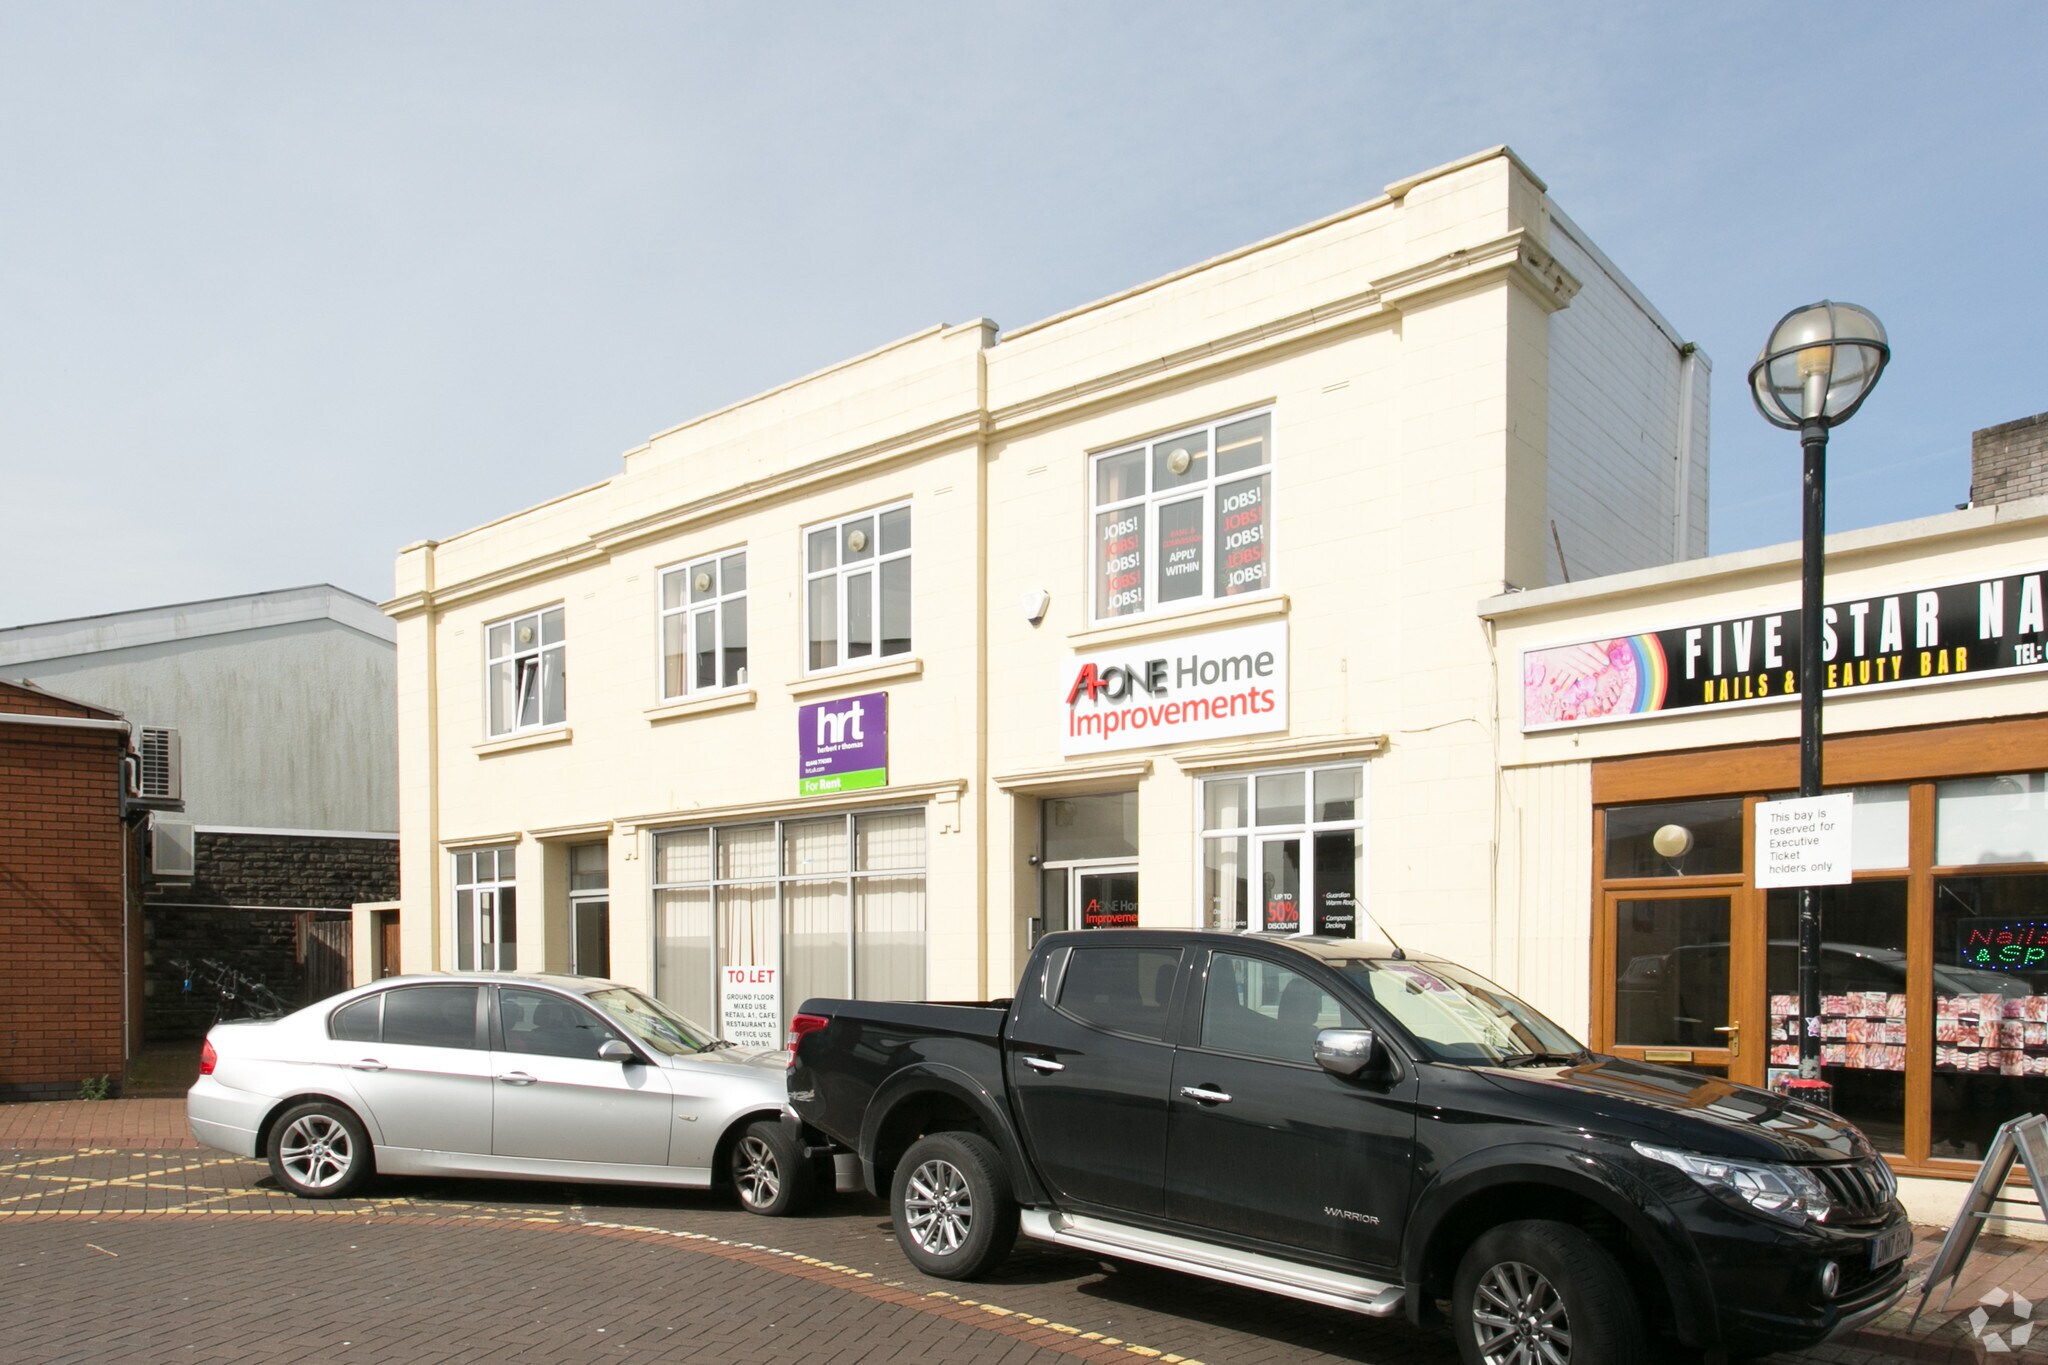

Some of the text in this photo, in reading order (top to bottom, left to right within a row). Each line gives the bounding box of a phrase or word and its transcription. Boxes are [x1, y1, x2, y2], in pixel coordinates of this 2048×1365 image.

[1222, 487, 1261, 514] JOBS!
[1104, 517, 1138, 540] JOBS!
[1223, 506, 1263, 532] JOBS!
[1105, 535, 1139, 558] JOBS!
[1225, 525, 1264, 550] JOBS!
[1106, 553, 1140, 575] JOBS!
[1169, 548, 1196, 562] APPLY
[1227, 544, 1265, 569] JOBS!
[1165, 561, 1200, 576] WITHIN
[1228, 562, 1266, 587] JOBS!
[1108, 571, 1141, 592] JOBS!
[1107, 587, 1142, 609] JOBS!
[1685, 615, 1783, 680] FIVE
[1823, 591, 1939, 662] STAR
[2014, 642, 2042, 666] TEL:
[1176, 651, 1274, 689] Home
[1704, 646, 1968, 703] NAILS & EAUTY BAR
[817, 700, 864, 745] hrt
[1069, 686, 1275, 740] Improvements
[817, 746, 837, 754] herbert
[841, 742, 863, 750] thomas
[805, 777, 841, 791] For Rent
[1770, 808, 1827, 823] This bay is
[1769, 821, 1835, 836] reserved for
[1769, 837, 1820, 849] Executive
[1770, 851, 1800, 861] Ticket
[1769, 861, 1832, 874] holders only
[1283, 893, 1293, 901] TO
[1086, 913, 1139, 925] Improveme
[1267, 901, 1298, 923] 50%
[1325, 914, 1353, 923] Composite
[1325, 922, 1346, 930] Decking
[1976, 948, 1990, 962] &
[728, 970, 775, 983] TO LET
[753, 993, 775, 1001] FLOOR
[735, 1030, 757, 1038] OFFICE
[1323, 1206, 1380, 1225] WARRIOR
